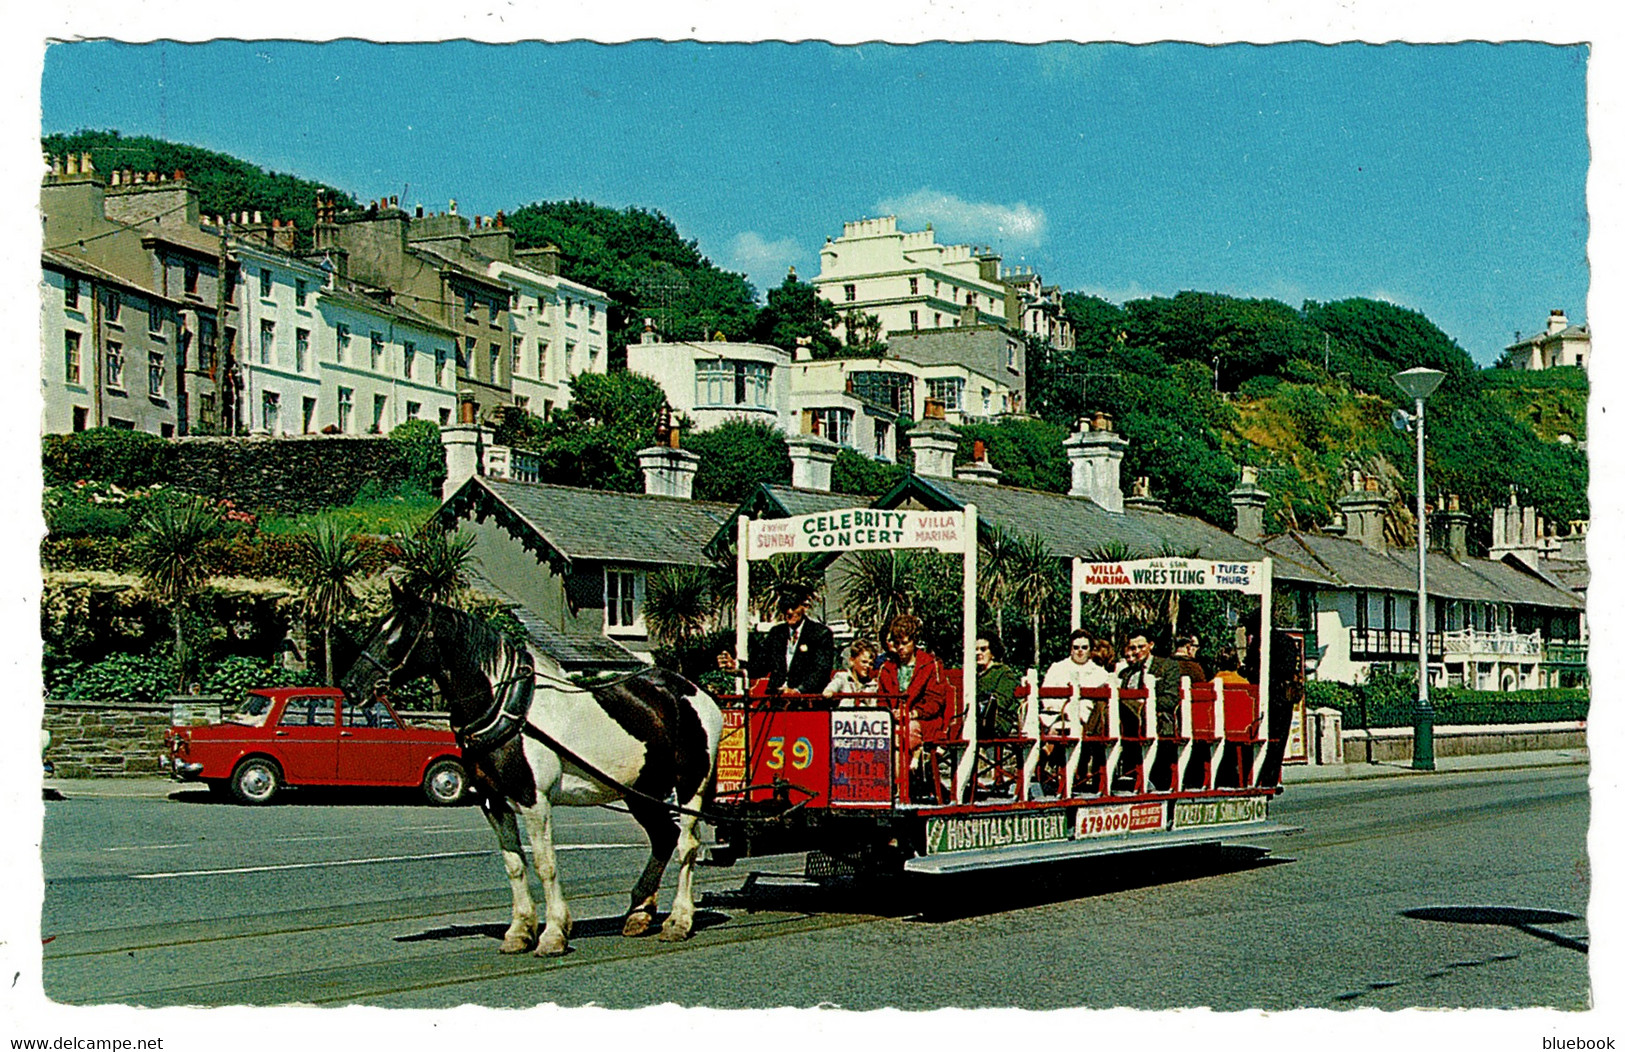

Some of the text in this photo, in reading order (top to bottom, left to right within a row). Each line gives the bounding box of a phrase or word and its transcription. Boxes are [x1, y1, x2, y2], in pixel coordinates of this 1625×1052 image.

[803, 510, 907, 534] CELEBRITY
[918, 517, 955, 528] VILLA
[757, 534, 796, 548] SUNDAY
[808, 529, 903, 547] CONCERT
[915, 530, 957, 541] MARINA
[1090, 565, 1124, 574] VILLA
[1133, 569, 1206, 585] WRESTLING
[1086, 576, 1131, 585] MARINA
[1216, 576, 1250, 586] THURS
[834, 720, 889, 736] PALACE
[766, 736, 814, 770] 39
[947, 813, 1066, 850] HOSPITALS LOTTERY
